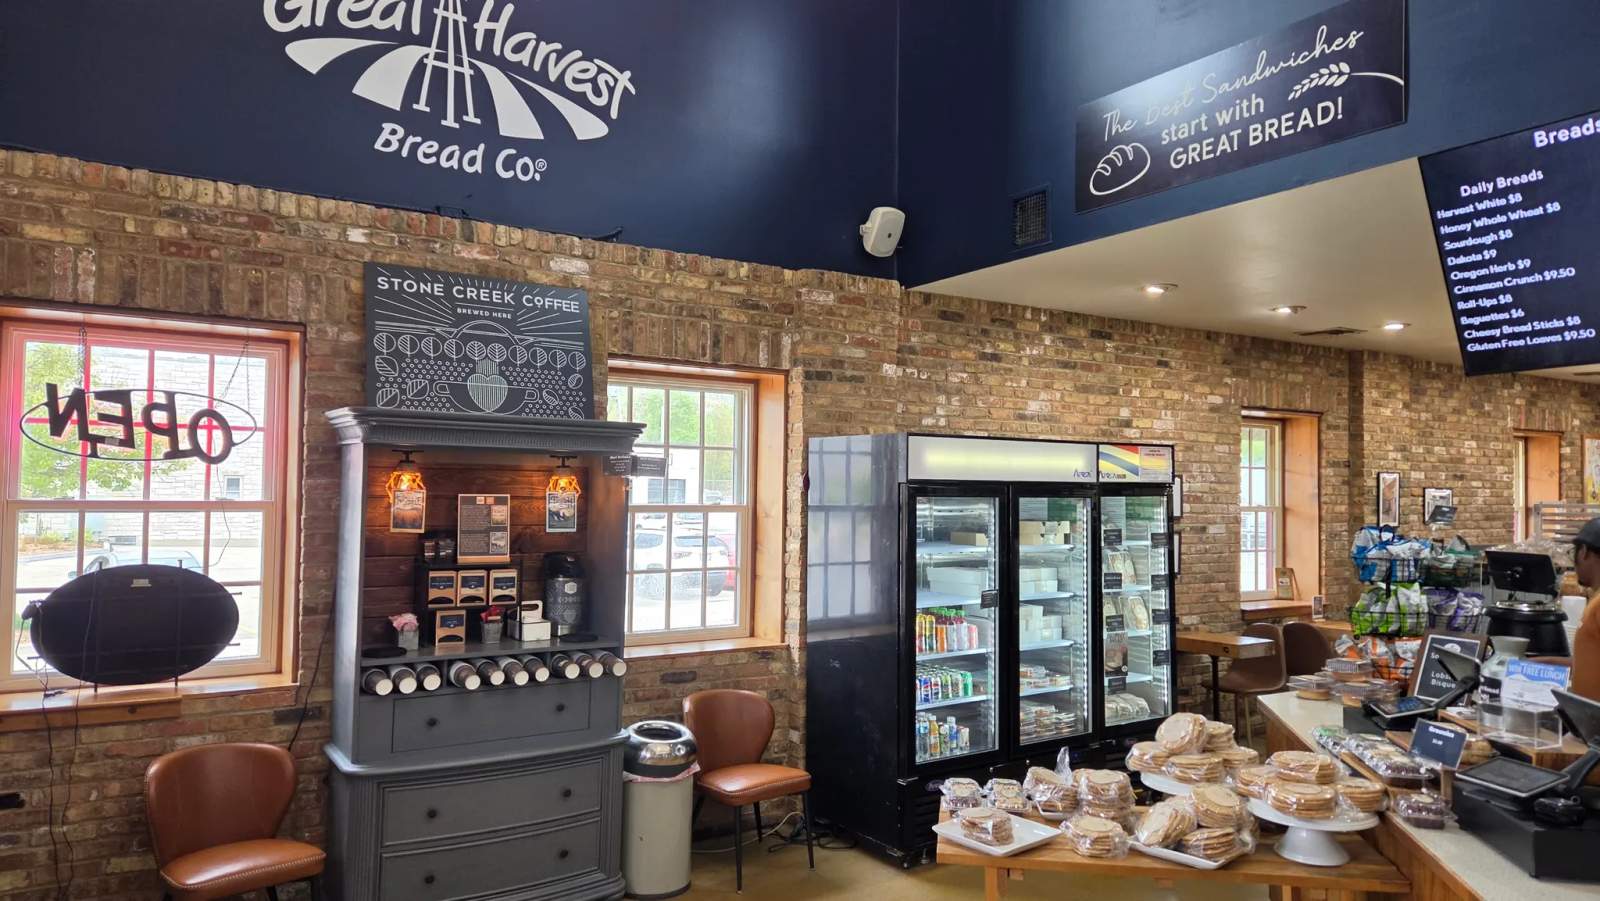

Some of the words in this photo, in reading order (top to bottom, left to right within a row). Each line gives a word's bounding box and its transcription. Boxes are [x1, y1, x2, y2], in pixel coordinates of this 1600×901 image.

[263, 0, 421, 36] Great
[474, 0, 636, 120] Harvest
[1103, 108, 1138, 142] The
[1201, 25, 1364, 103] Sandwiches
[1161, 112, 1208, 145] start
[1215, 93, 1265, 126] with
[1169, 129, 1242, 169] GREAT
[1249, 96, 1343, 147] BREAD!
[374, 123, 485, 175] Bread
[1460, 181, 1494, 197] Daily
[1496, 169, 1544, 189] Breads
[1436, 204, 1475, 219] Harvest
[1475, 197, 1507, 211] White
[1508, 192, 1523, 205] $8
[1440, 221, 1472, 235] Honey
[1473, 214, 1507, 228] Whole
[1508, 206, 1544, 220] Wheat
[1546, 201, 1561, 213] $8
[1443, 232, 1498, 250] Sourdough
[1498, 228, 1513, 240] $8
[1447, 253, 1482, 266] Dakota
[1483, 249, 1497, 260] $9
[1451, 267, 1489, 280] Oregon
[1489, 262, 1516, 274] Herb
[1517, 258, 1531, 269] $9
[376, 276, 444, 296] STONE
[452, 285, 516, 305] CREEK
[522, 294, 580, 313] COFFEE
[1454, 281, 1503, 295] Cinnamon
[1504, 273, 1543, 287] Crunch
[1544, 267, 1576, 281] $9.50
[457, 307, 490, 317] BREWED
[492, 311, 512, 319] HERE
[1457, 297, 1498, 310] Roll-Ups
[1498, 293, 1513, 304] $8
[1460, 311, 1510, 325] Baguettes
[1510, 308, 1525, 319] $6
[1464, 327, 1501, 339] Cheesy
[1502, 323, 1532, 334] Bread
[1533, 319, 1565, 330] Sticks
[1566, 315, 1581, 326] $8
[1467, 340, 1501, 352] Gluten
[1501, 338, 1525, 349] Free
[1526, 333, 1563, 345] Loaves
[1563, 328, 1596, 341] $9.50
[1431, 678, 1457, 689] Bisque
